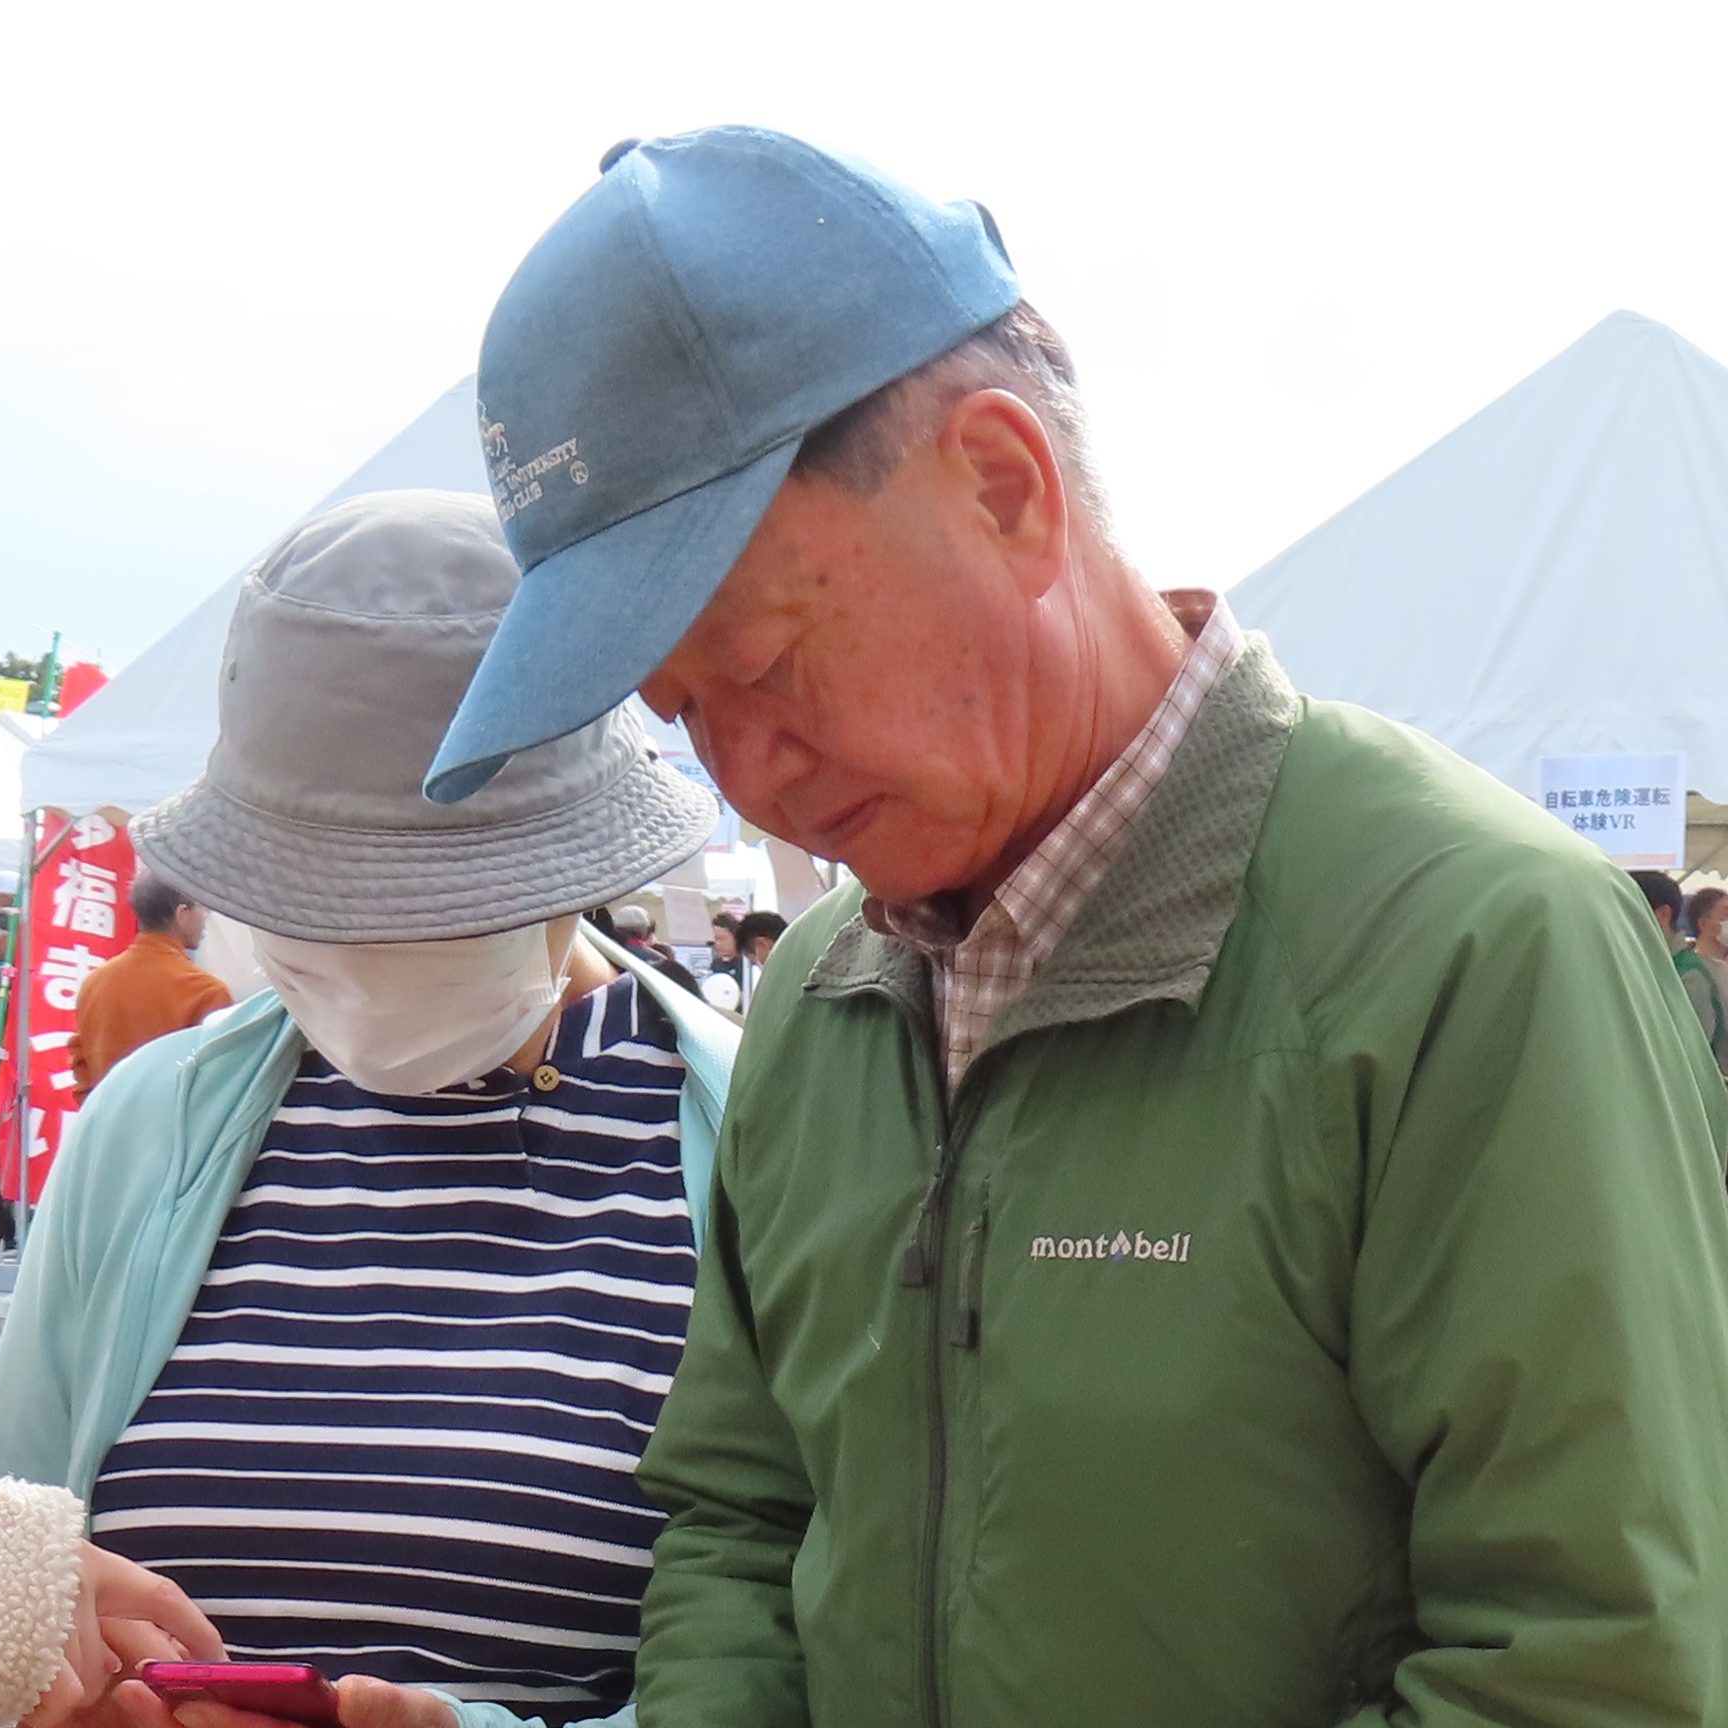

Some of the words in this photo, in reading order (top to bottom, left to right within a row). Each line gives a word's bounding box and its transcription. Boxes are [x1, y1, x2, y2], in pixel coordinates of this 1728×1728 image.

[1545, 787, 1671, 810] 自転車危険運転
[1572, 813, 1637, 832] 体験VR
